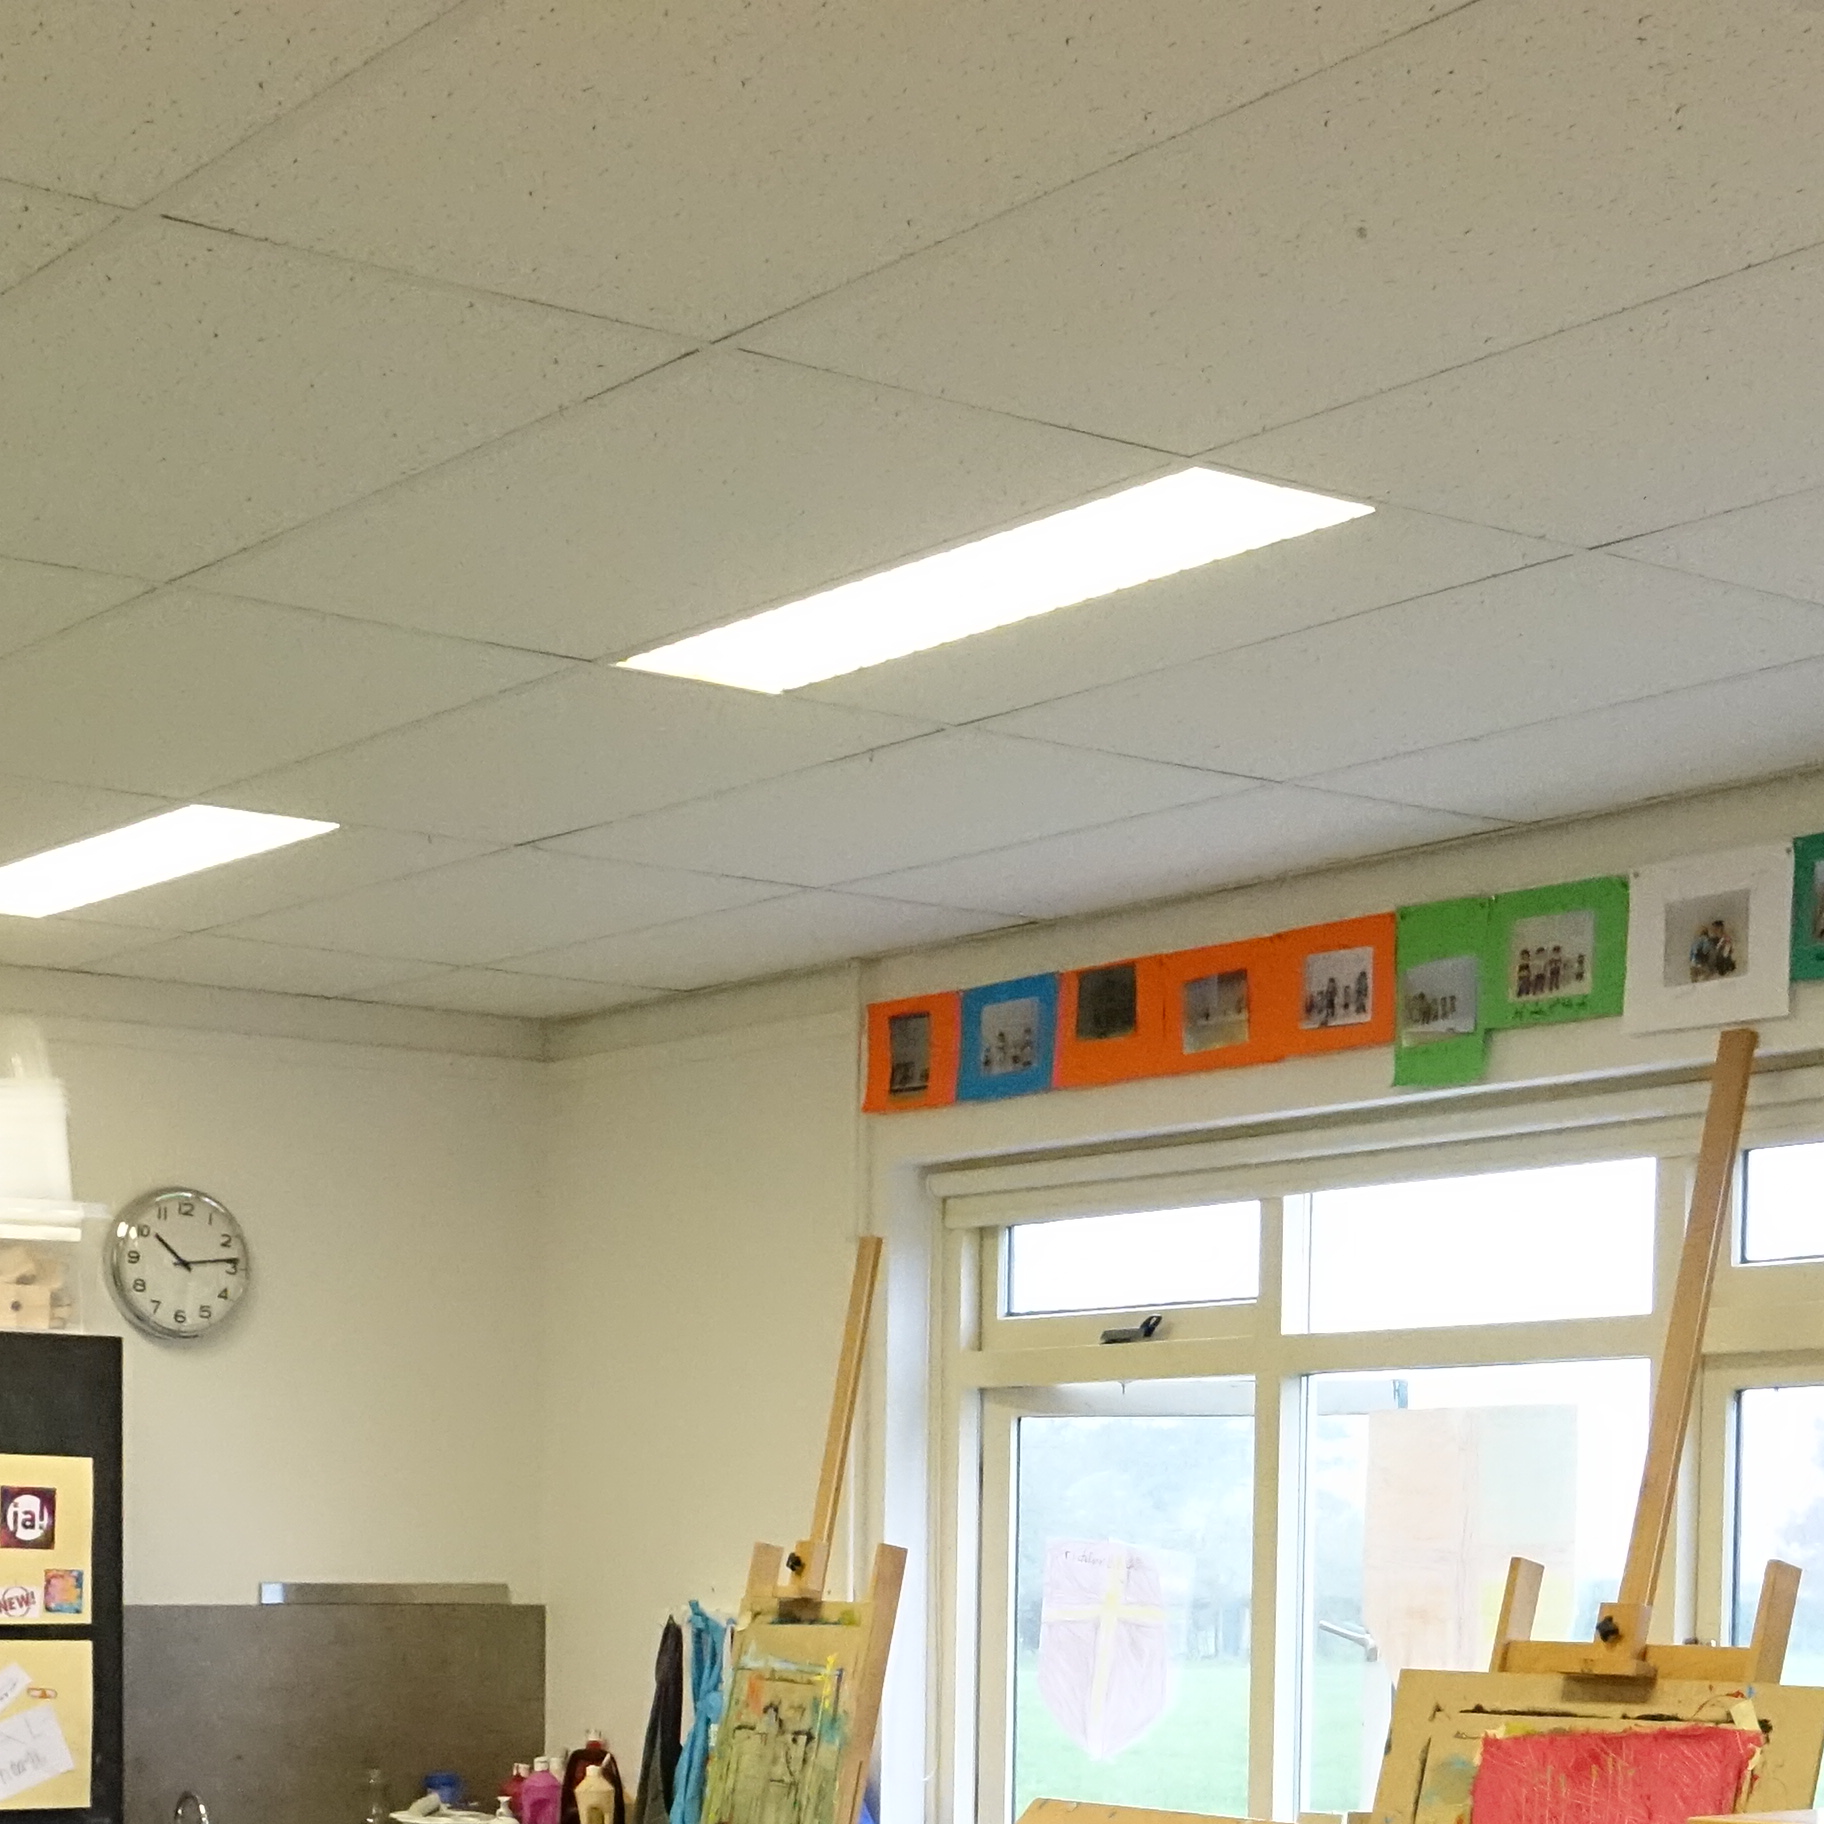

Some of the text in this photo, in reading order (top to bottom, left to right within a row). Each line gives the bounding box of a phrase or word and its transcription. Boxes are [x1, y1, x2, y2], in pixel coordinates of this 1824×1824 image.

[156, 1206, 168, 1221] 11
[178, 1202, 195, 1217] 12
[136, 1224, 151, 1238] 10
[219, 1233, 232, 1248] 2
[127, 1250, 141, 1264] 9
[132, 1278, 147, 1293] 8
[217, 1286, 229, 1300] 4
[150, 1299, 162, 1315] 7
[198, 1304, 212, 1319] 5
[173, 1309, 187, 1324] 6
